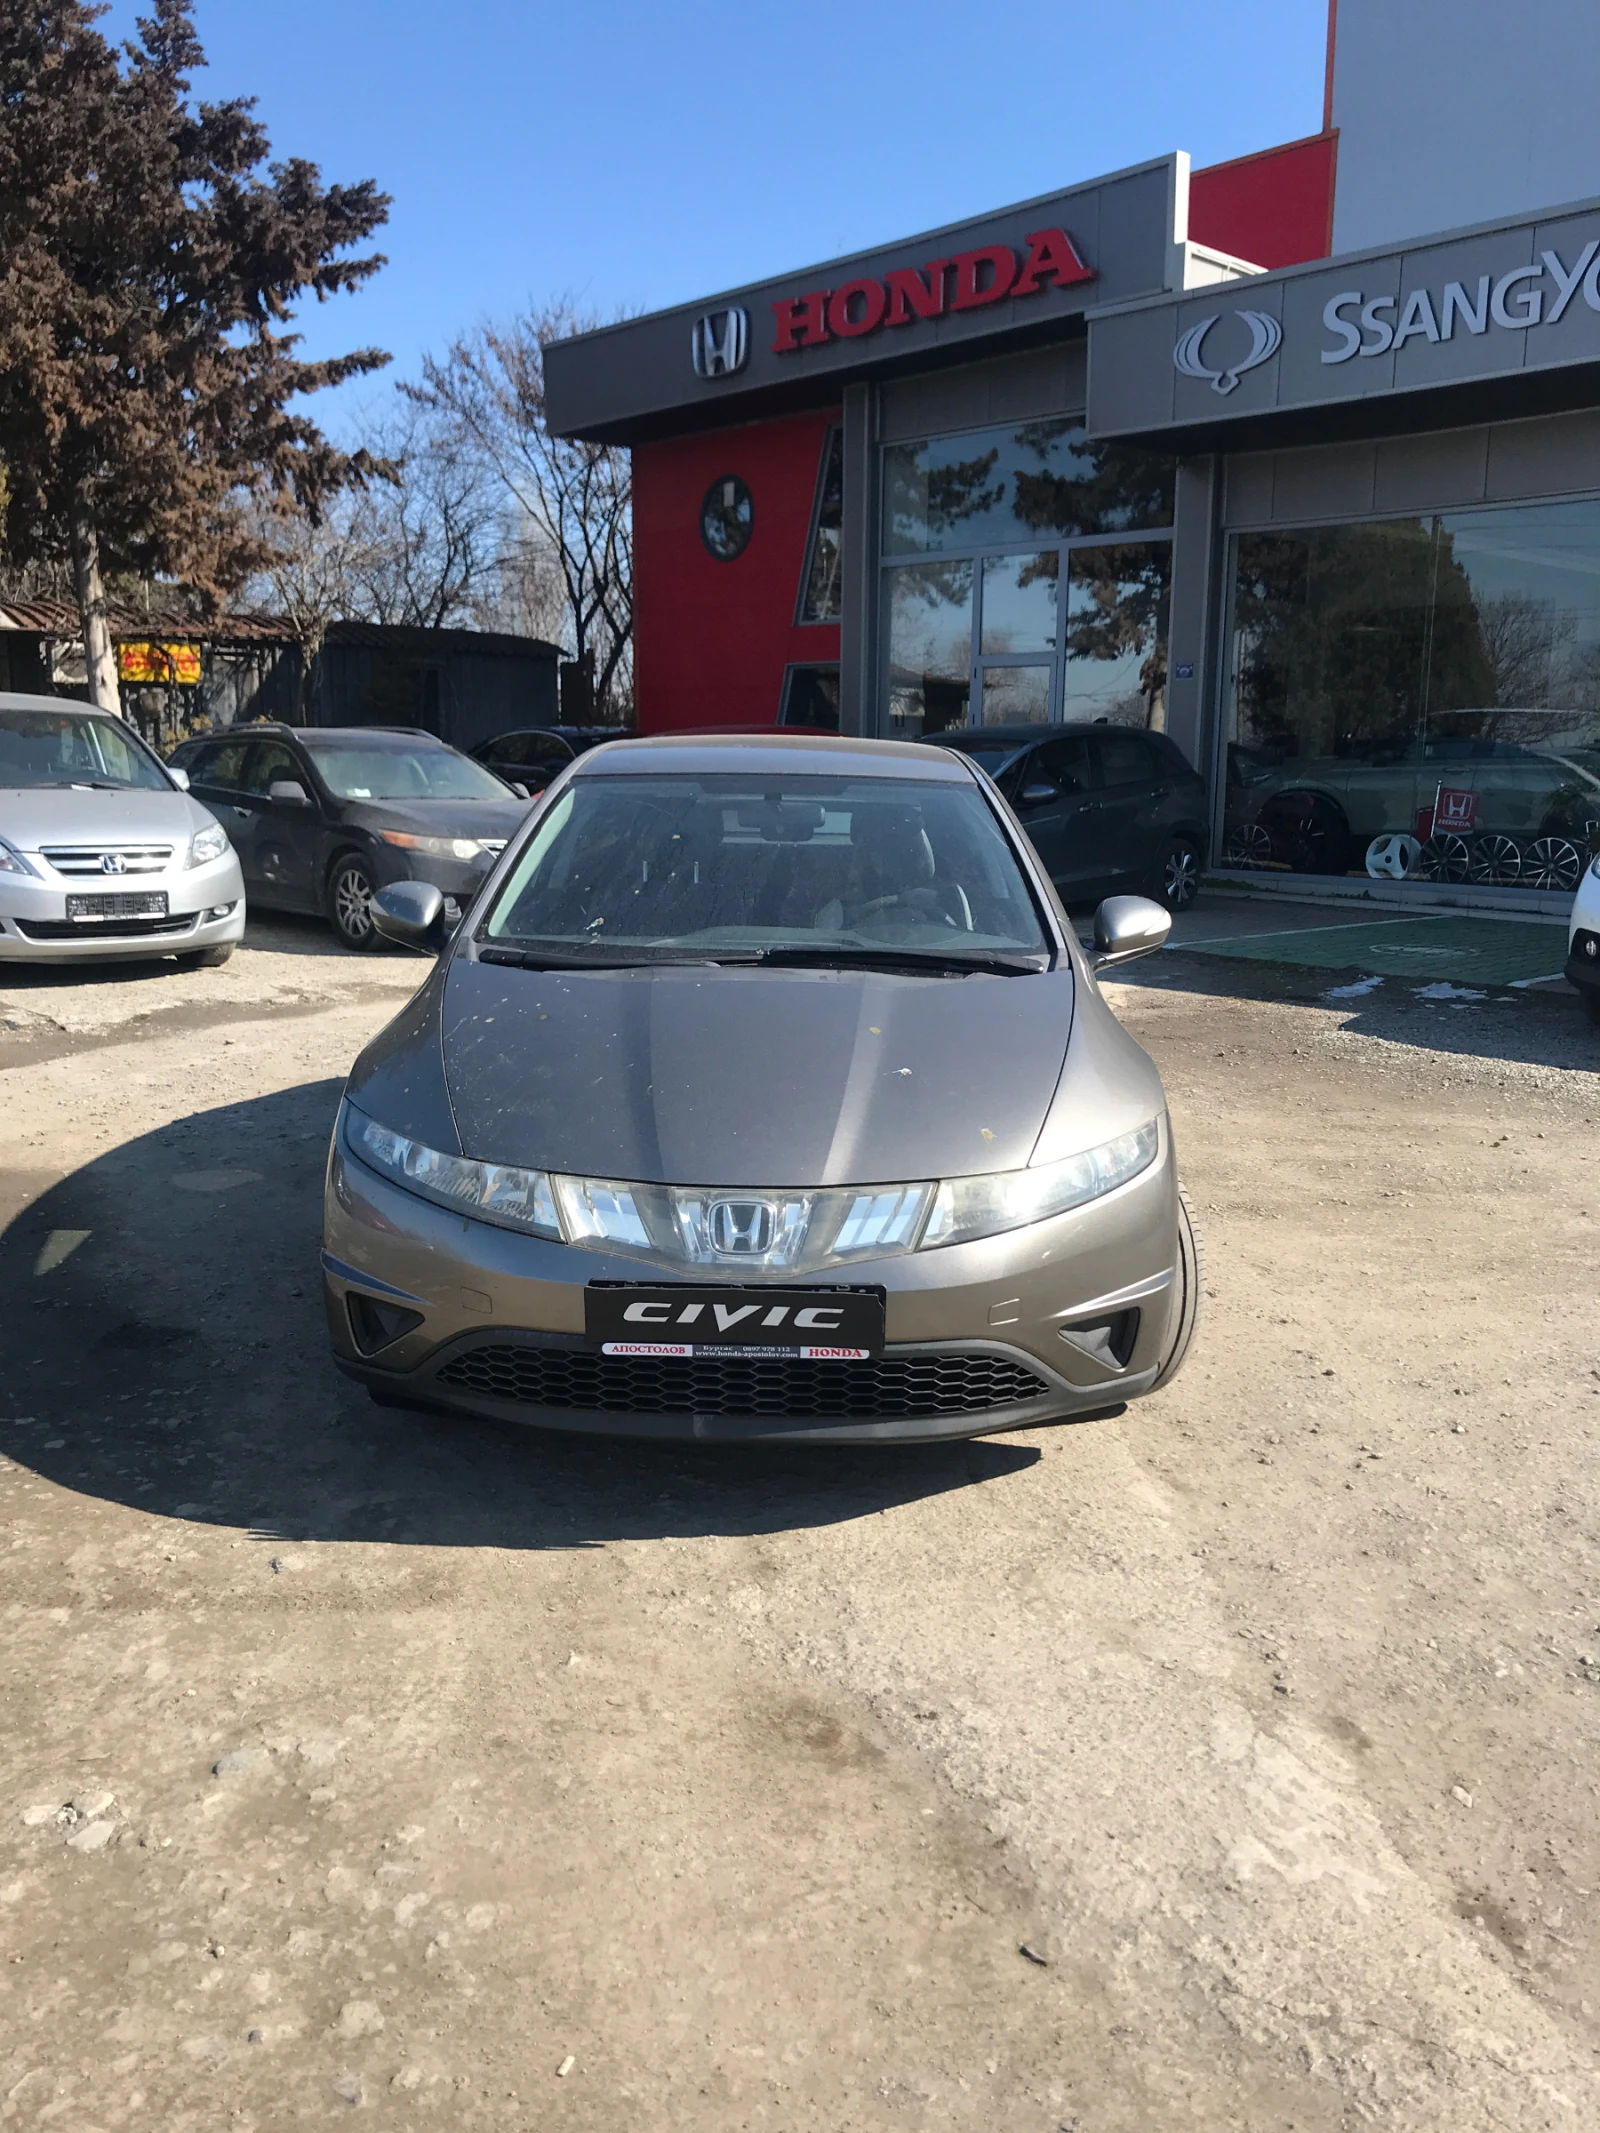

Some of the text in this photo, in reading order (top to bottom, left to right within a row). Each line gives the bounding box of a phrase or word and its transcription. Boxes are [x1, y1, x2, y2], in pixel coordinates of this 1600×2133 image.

[770, 227, 1093, 352] HONDA
[1438, 819, 1470, 827] HONDA
[623, 1302, 844, 1332] CIVIC
[611, 1345, 686, 1355] АПОСТОЛОВ
[695, 1350, 798, 1358] www.honda-apostolov.com
[808, 1348, 862, 1358] HONDA
